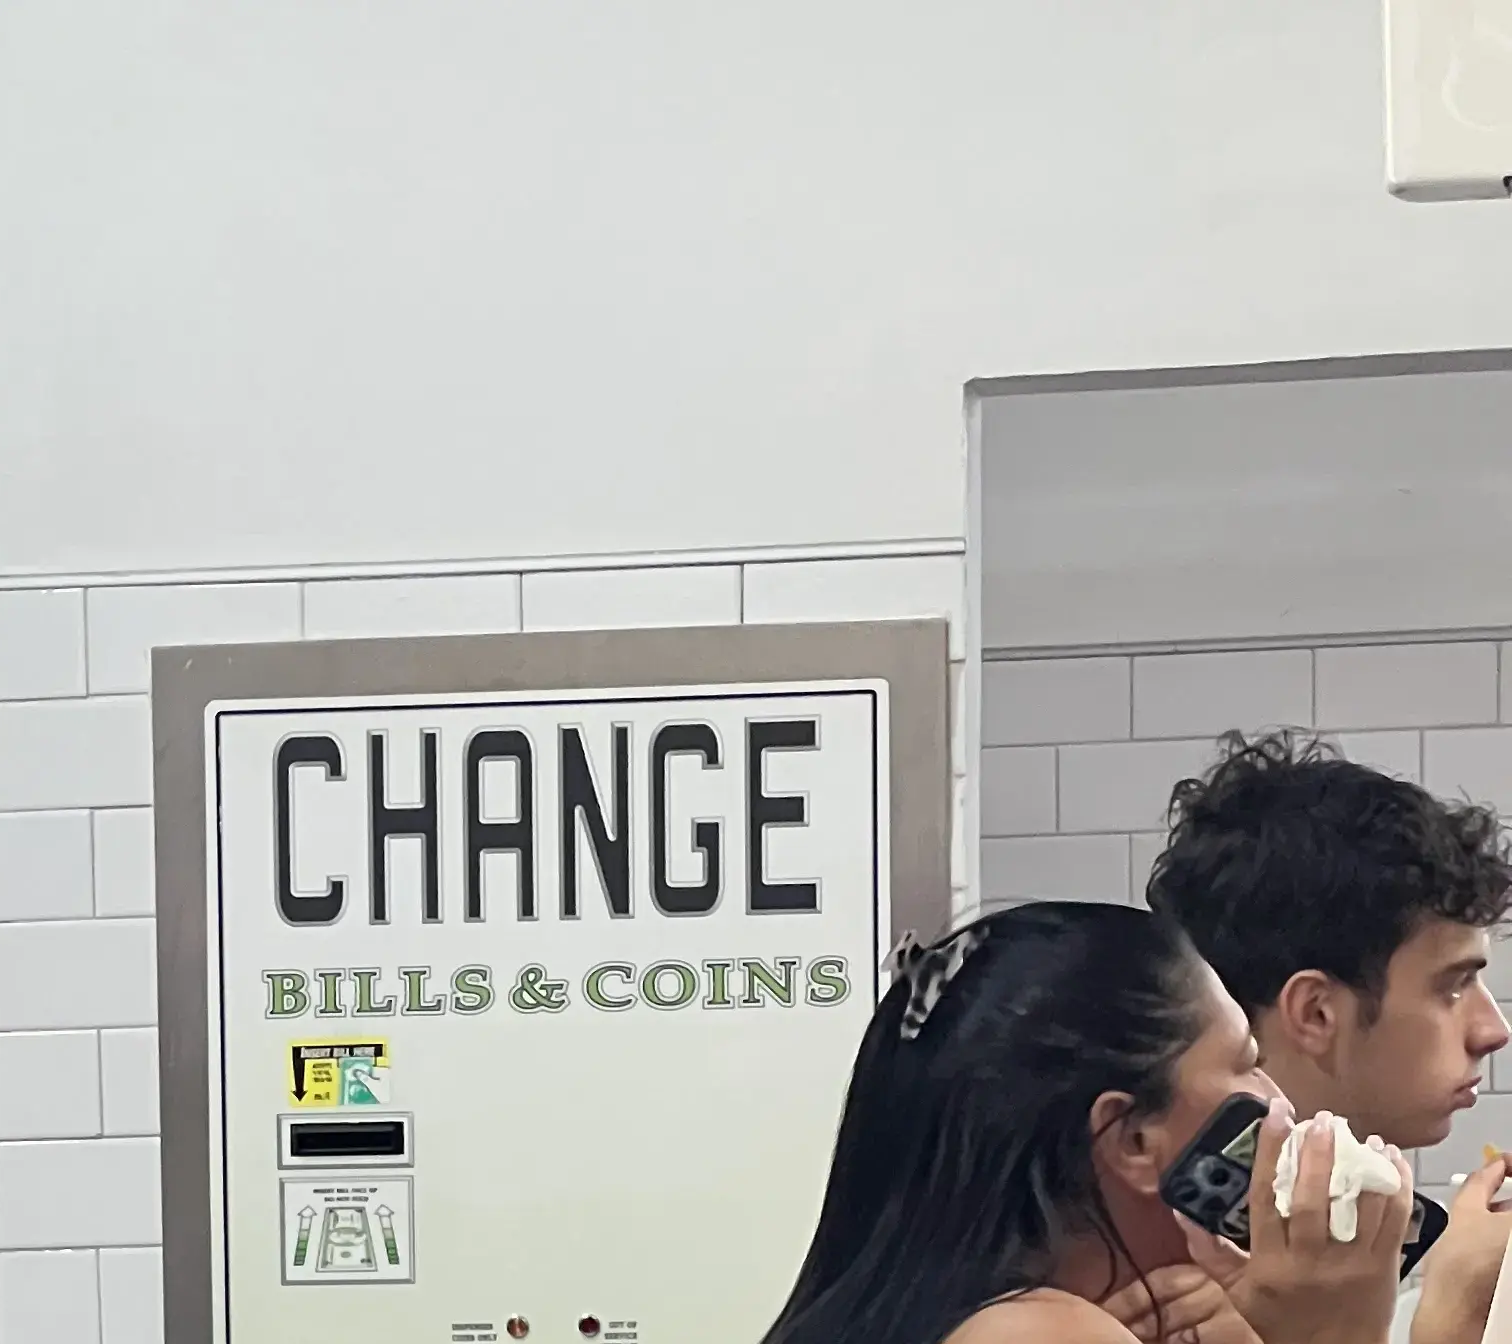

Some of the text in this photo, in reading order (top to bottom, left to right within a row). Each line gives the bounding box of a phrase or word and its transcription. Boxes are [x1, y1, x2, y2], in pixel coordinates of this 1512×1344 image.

[273, 714, 823, 926] CHANGE
[261, 956, 851, 1018] BILLS & COINS
